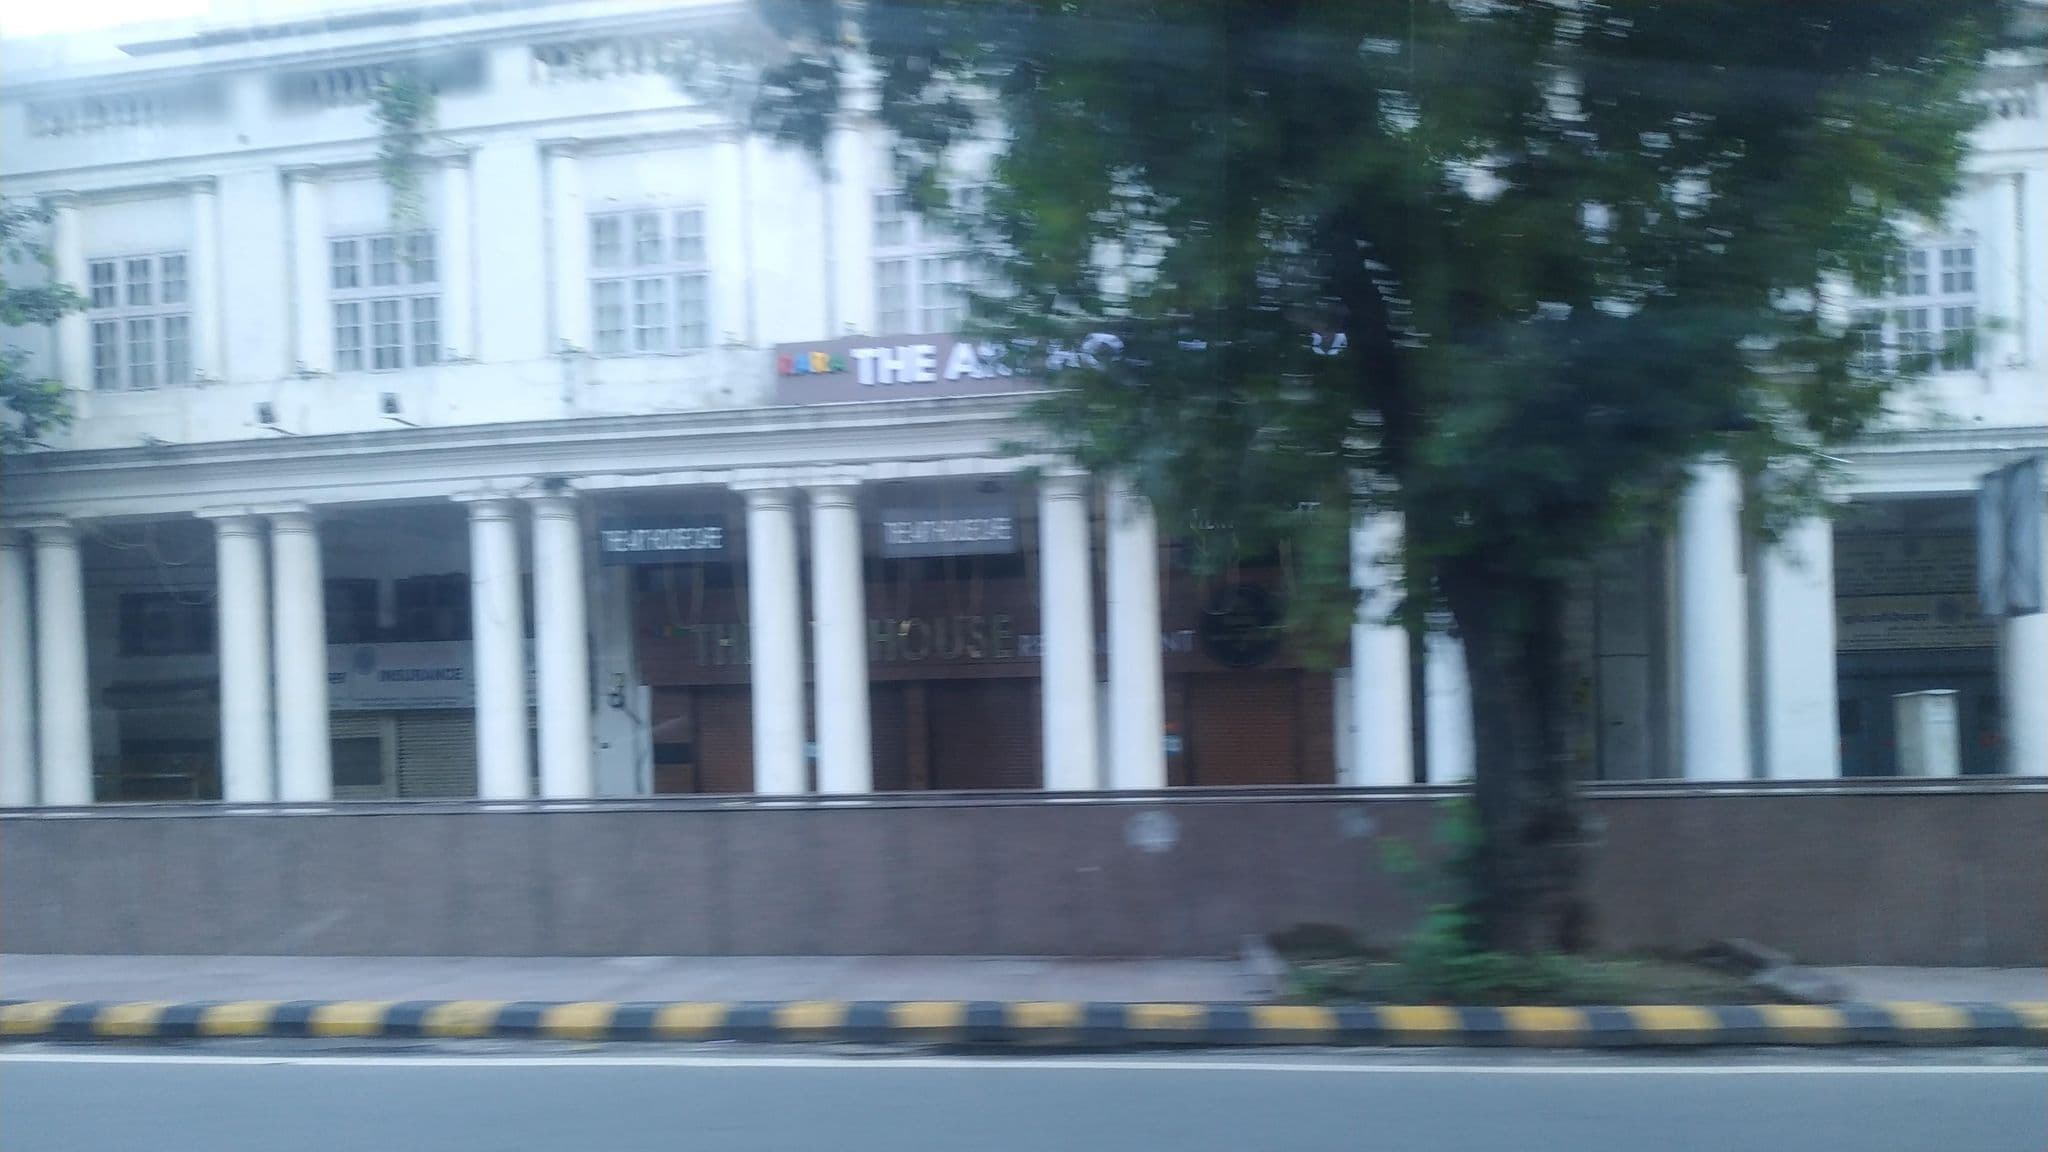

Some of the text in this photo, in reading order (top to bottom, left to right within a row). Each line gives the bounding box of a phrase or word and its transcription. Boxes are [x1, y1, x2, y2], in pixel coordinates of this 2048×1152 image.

[850, 342, 938, 386] THE
[868, 613, 1015, 663] HOUSE
[378, 667, 464, 682] INSURANCE
